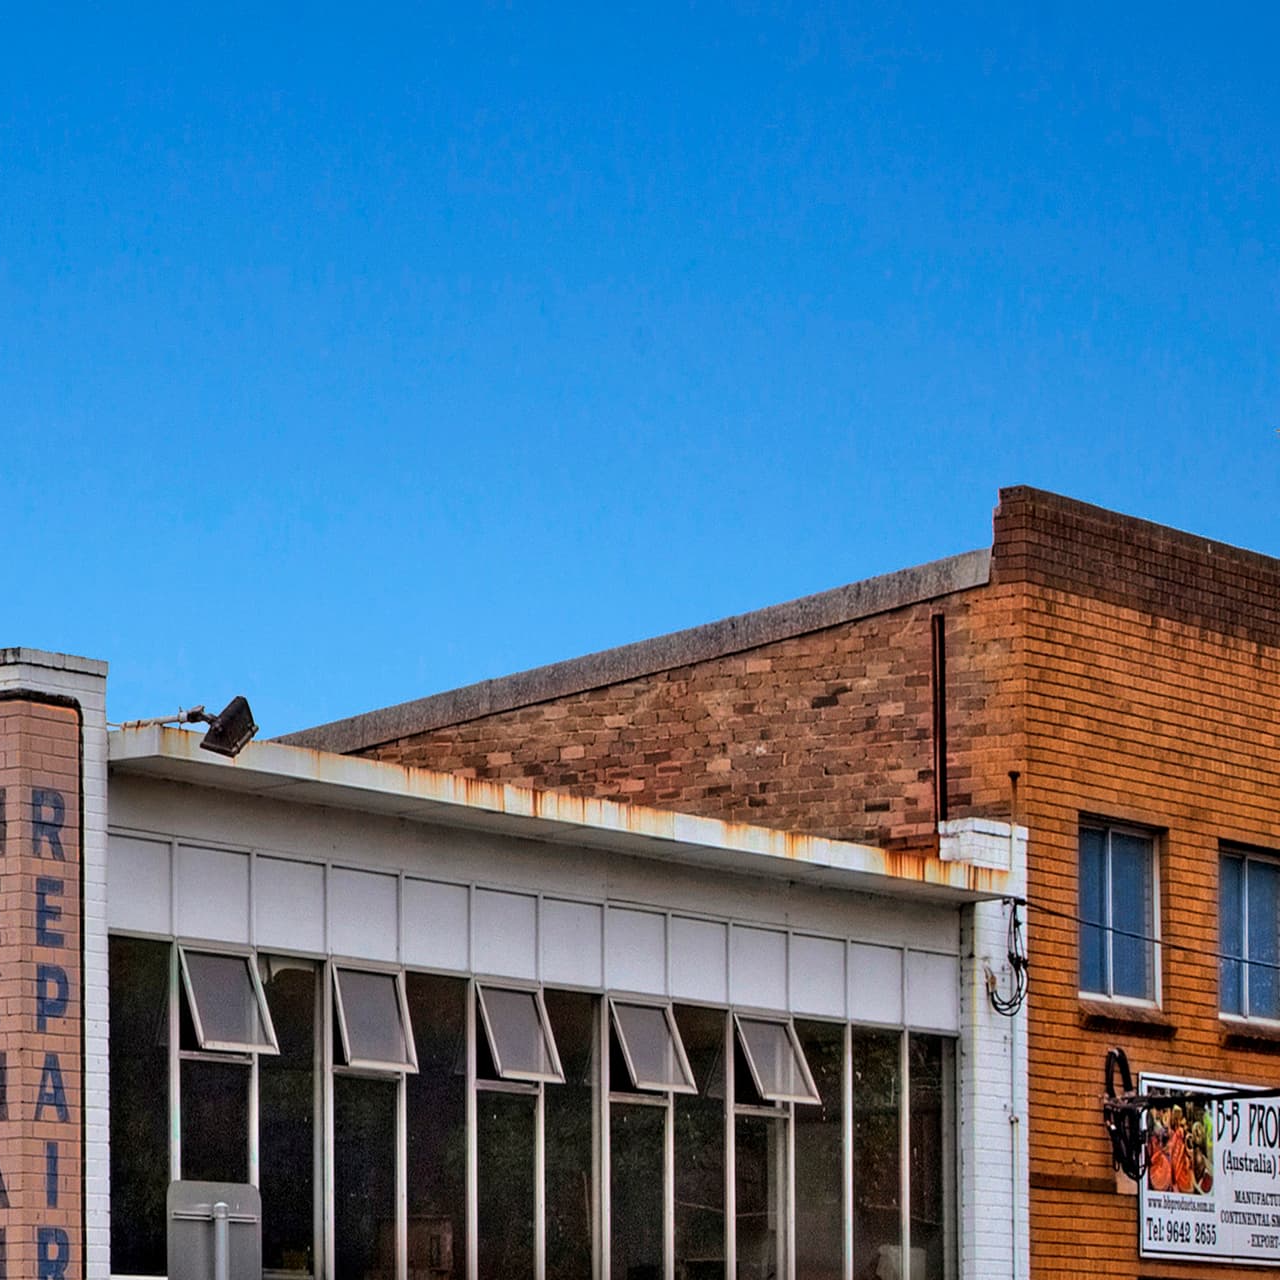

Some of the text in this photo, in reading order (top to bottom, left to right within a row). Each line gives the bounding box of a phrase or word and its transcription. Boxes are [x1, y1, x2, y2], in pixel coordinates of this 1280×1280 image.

[1248, 1103, 1280, 1149] PRO
[1222, 1149, 1277, 1180] (Australia)
[1146, 1217, 1217, 1246] Tel: 9642 2655
